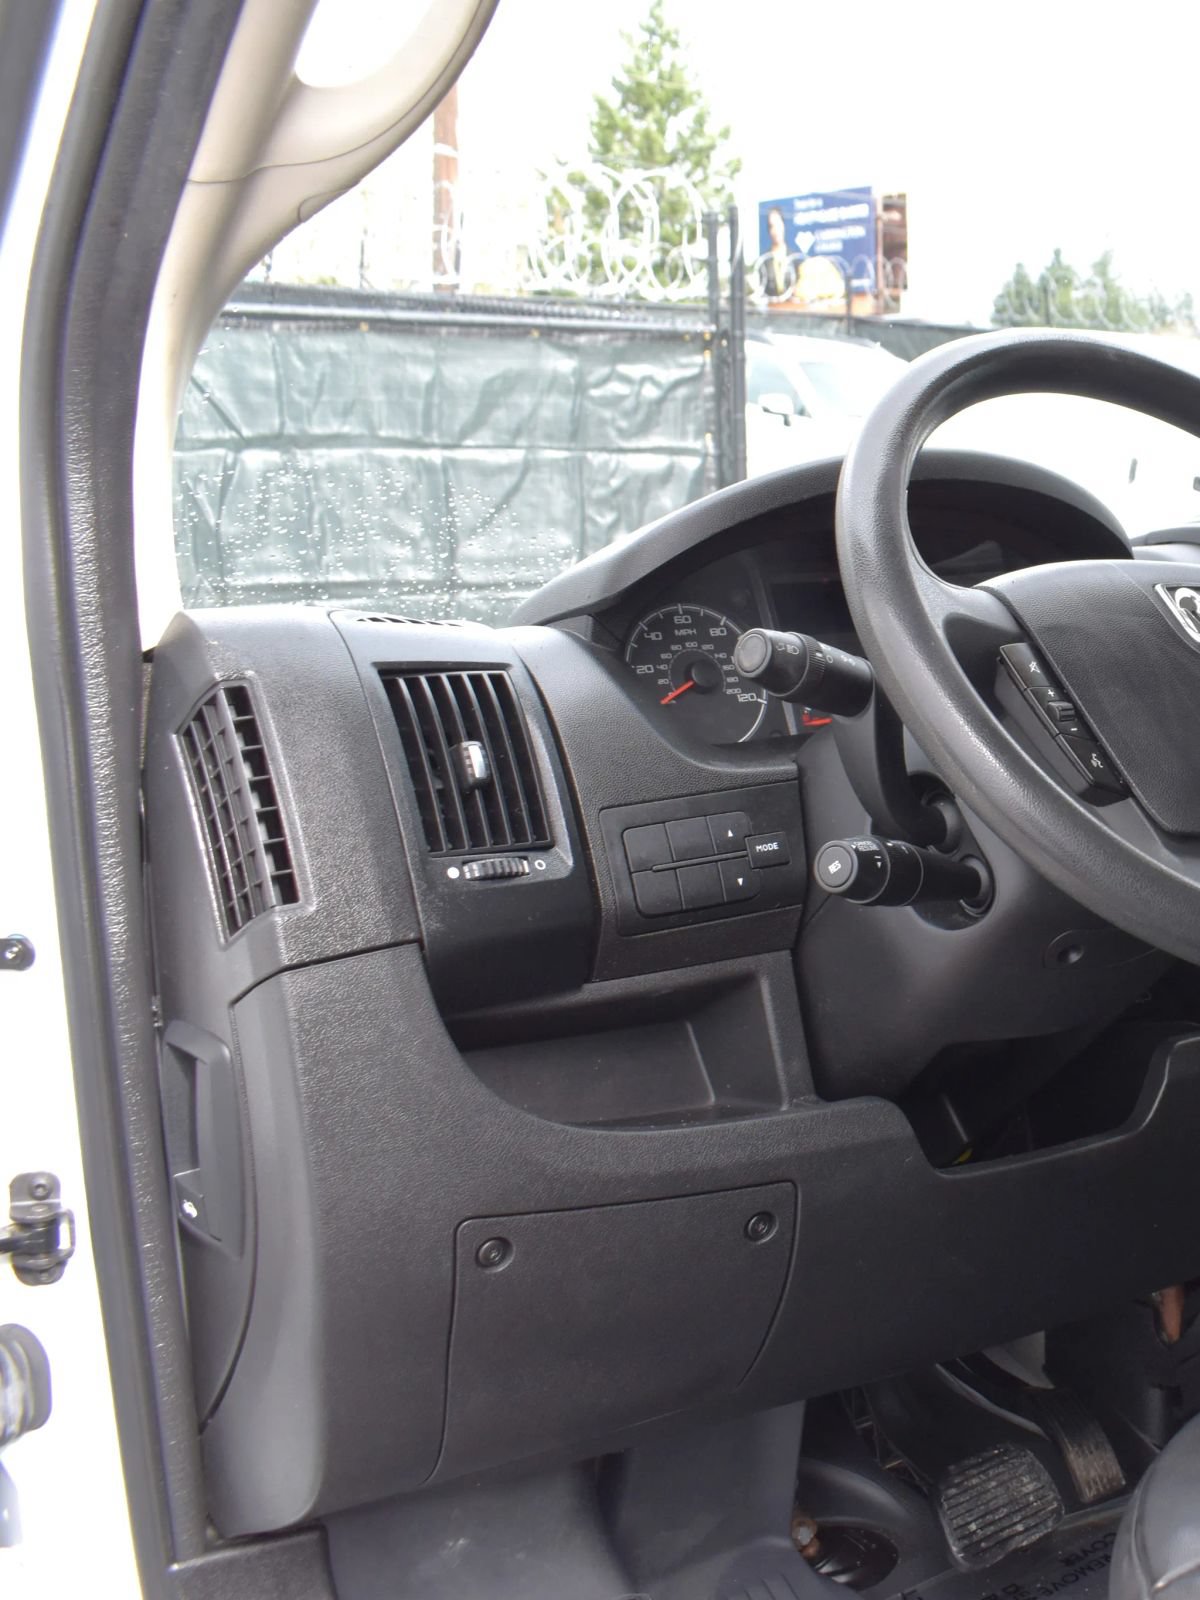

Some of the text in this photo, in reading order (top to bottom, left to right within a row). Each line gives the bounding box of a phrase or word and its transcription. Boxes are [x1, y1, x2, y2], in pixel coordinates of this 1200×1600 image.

[674, 615, 692, 624] 60
[644, 632, 663, 641] 40
[675, 629, 697, 637] MPH
[709, 627, 728, 637] 80
[636, 664, 654, 674] 20
[737, 692, 757, 702] 120
[755, 842, 780, 853] MODE
[827, 860, 842, 874] RES
